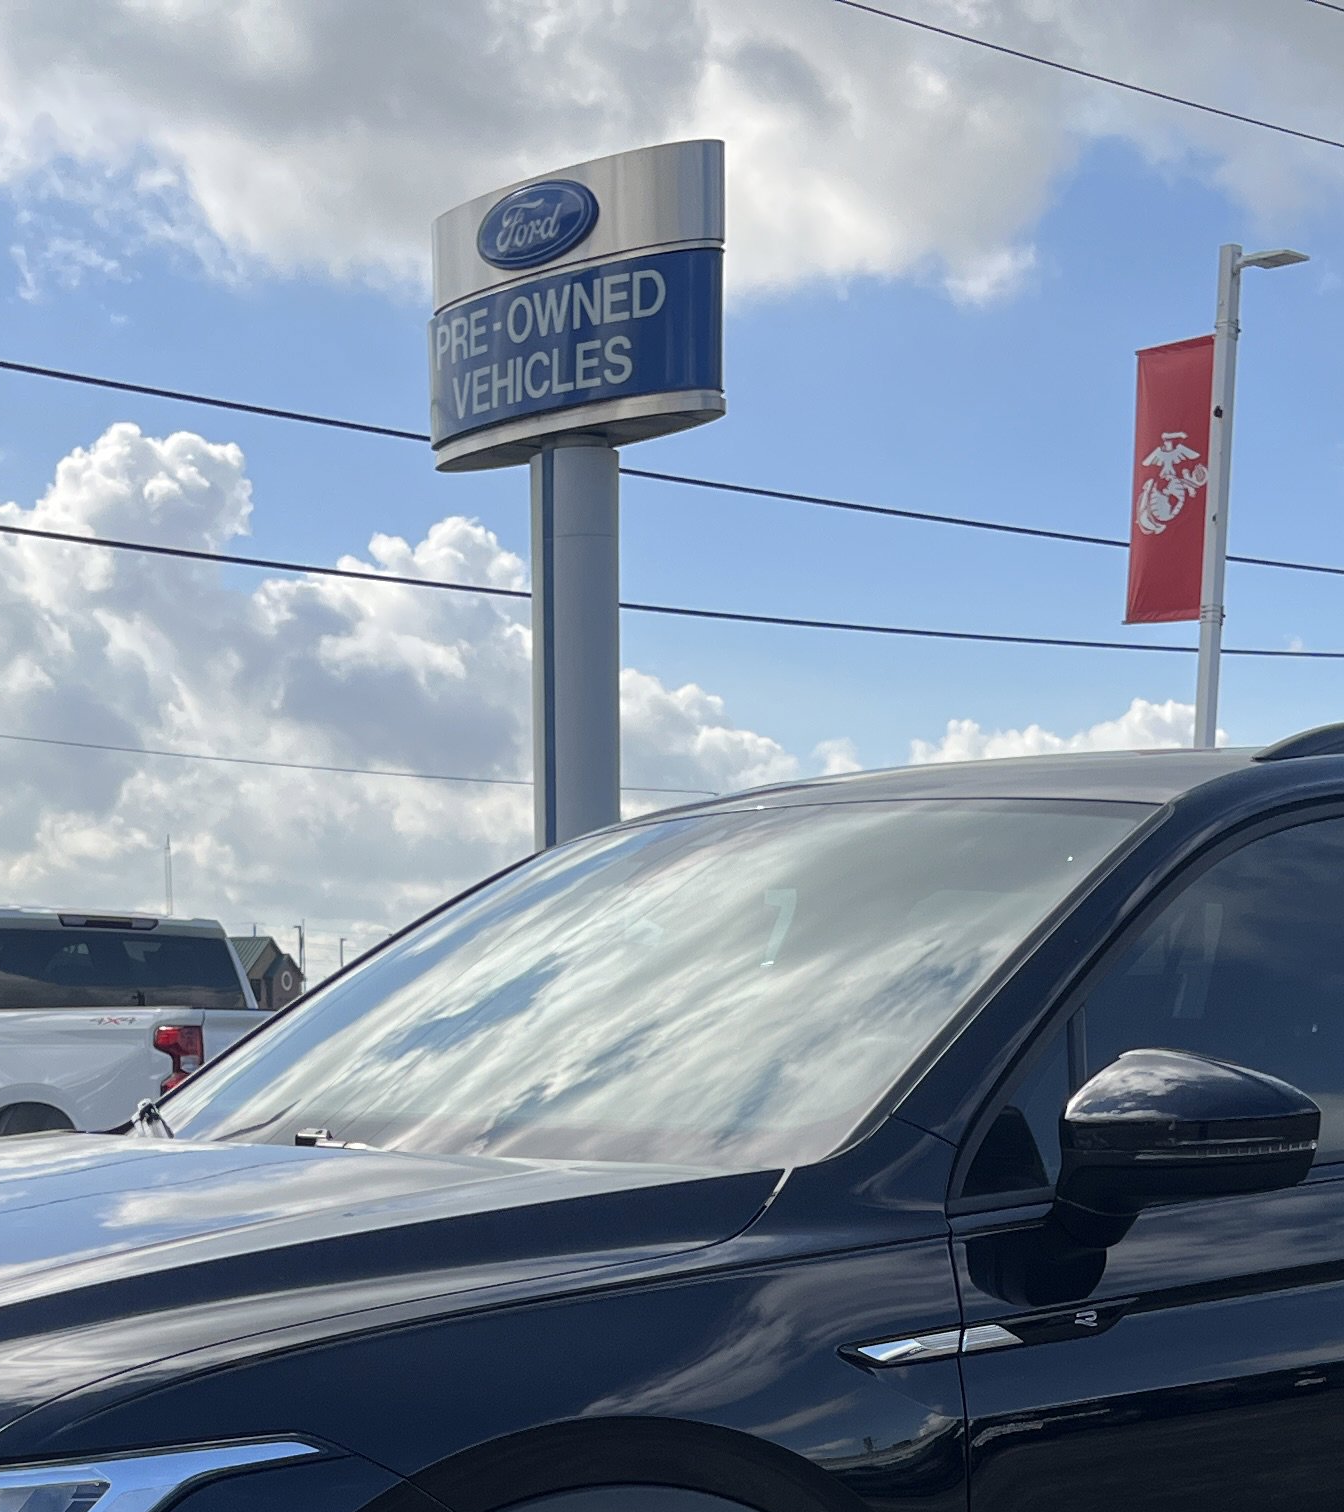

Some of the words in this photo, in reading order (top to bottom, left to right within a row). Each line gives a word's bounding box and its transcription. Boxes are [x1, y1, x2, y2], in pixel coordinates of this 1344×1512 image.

[496, 198, 561, 252] Ford
[436, 269, 667, 371] PRE-OWNED
[452, 335, 633, 419] VEHICLES
